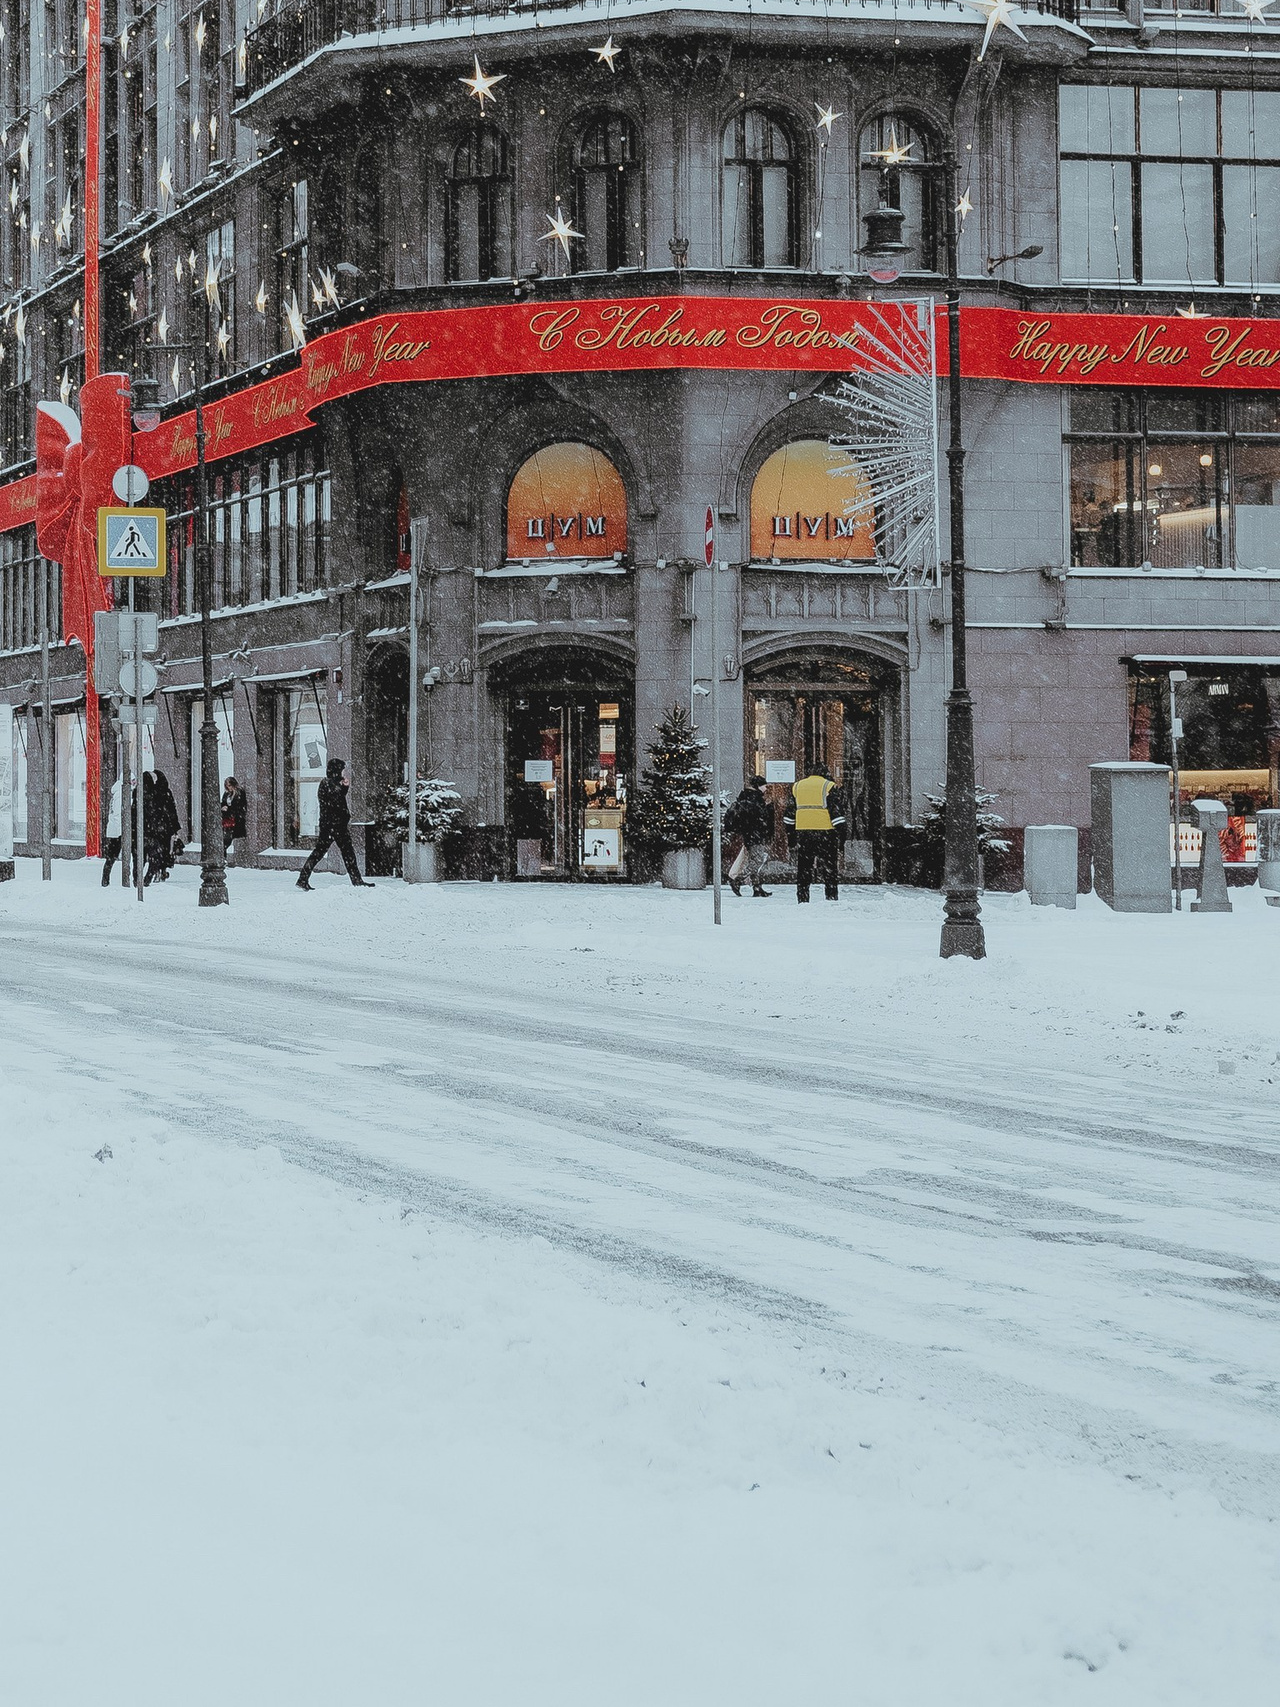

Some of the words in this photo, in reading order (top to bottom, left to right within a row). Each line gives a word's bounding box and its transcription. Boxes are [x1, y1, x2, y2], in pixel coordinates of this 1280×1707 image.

[367, 321, 431, 378] Year
[530, 306, 579, 351] С
[575, 304, 726, 350] Новым
[736, 305, 860, 349] Годом
[1009, 320, 1109, 375] Happy
[1111, 324, 1189, 365] New
